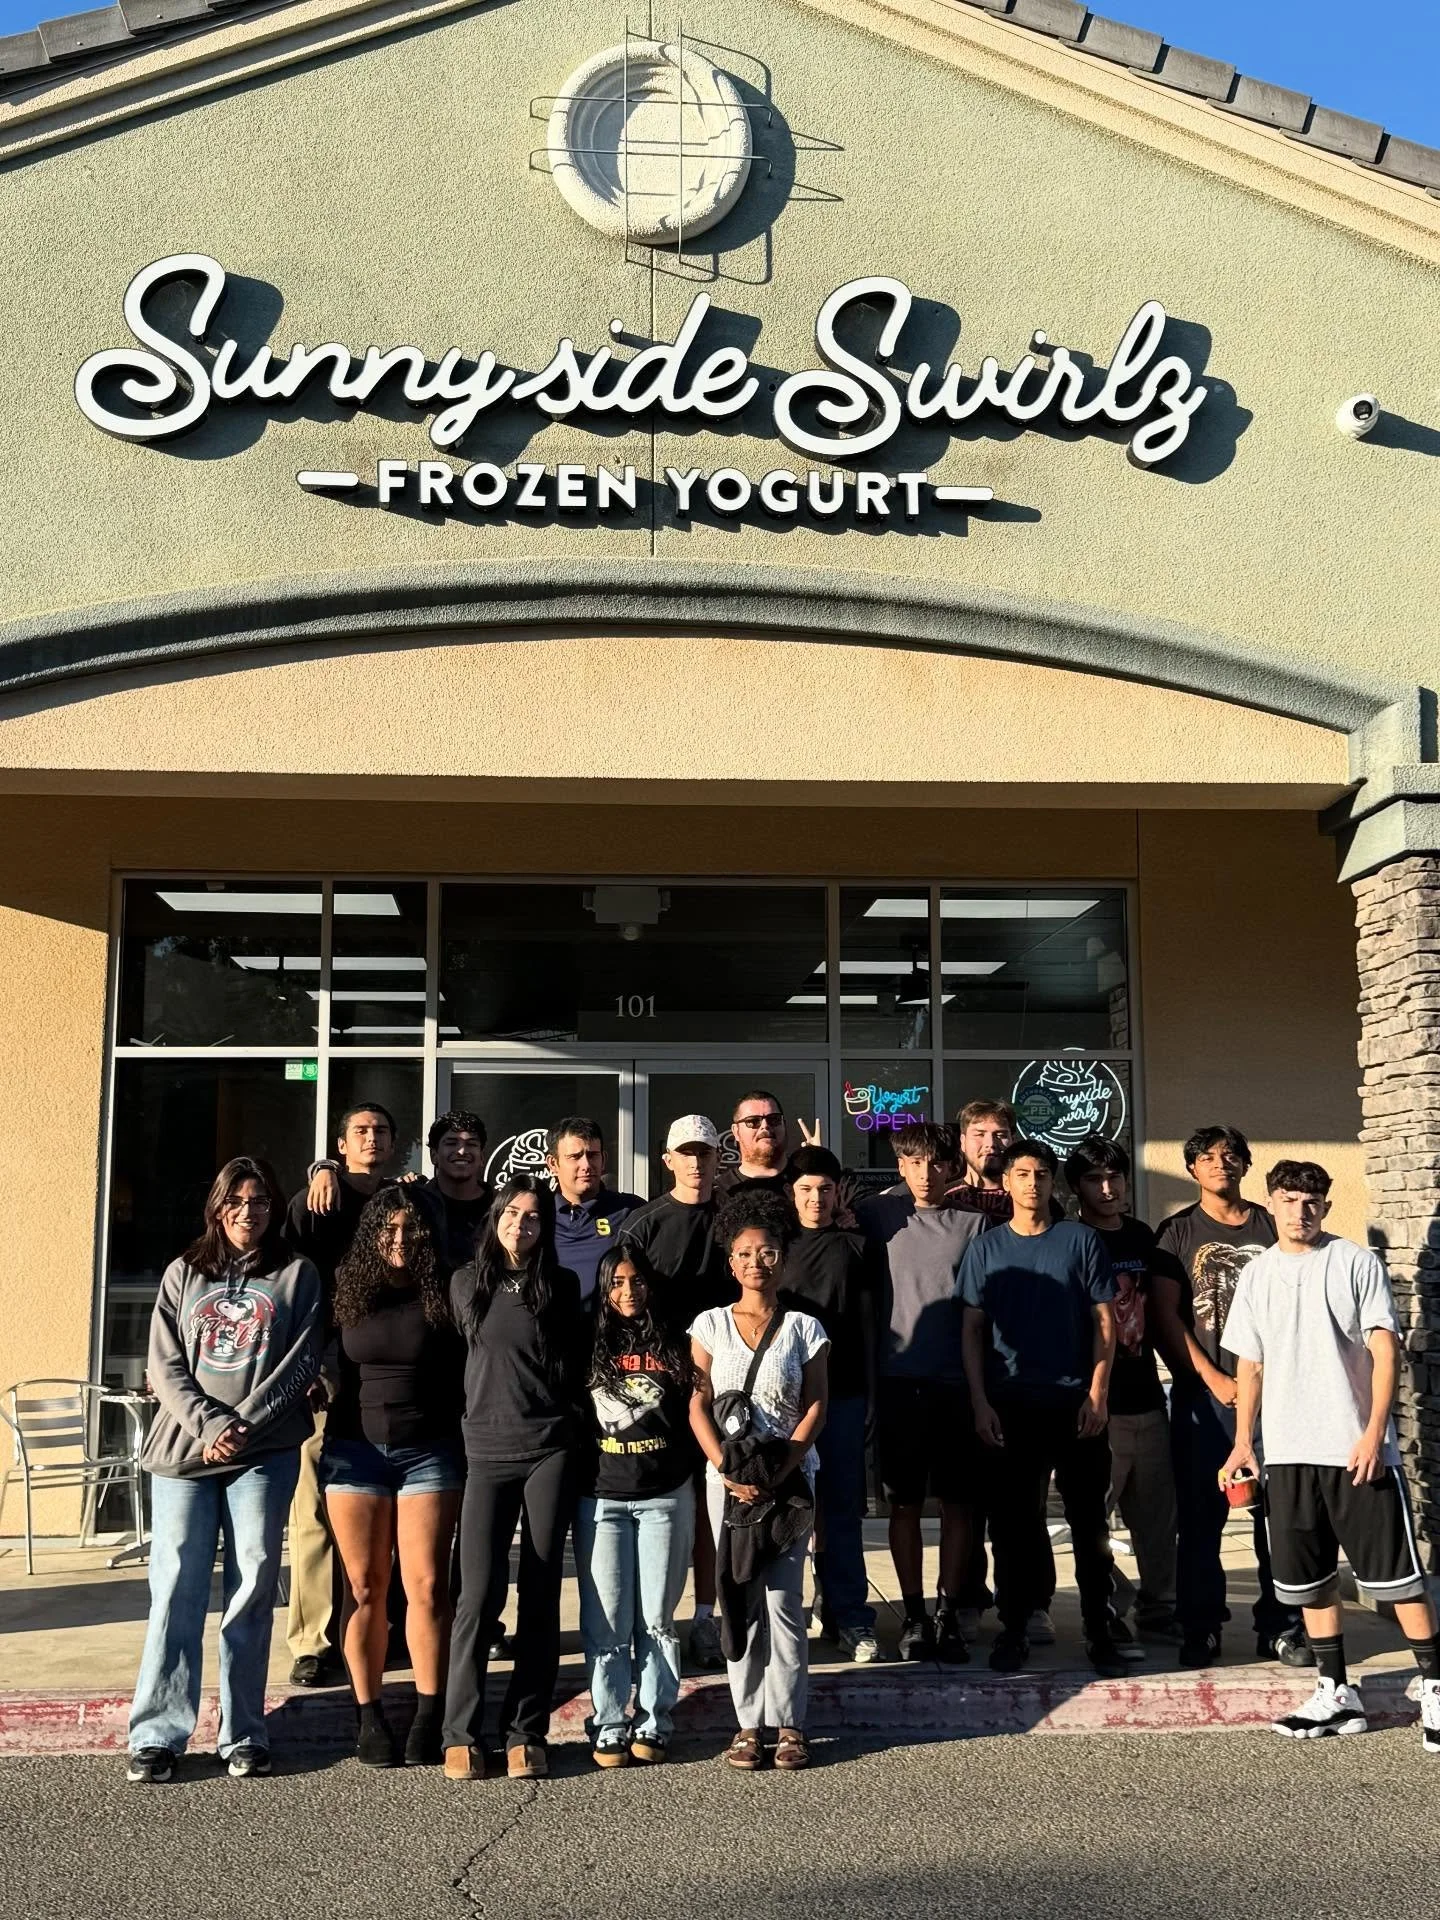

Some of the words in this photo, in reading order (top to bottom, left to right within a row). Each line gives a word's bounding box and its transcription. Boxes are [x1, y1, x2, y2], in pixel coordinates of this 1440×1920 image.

[774, 276, 1208, 462] Swirlz
[378, 460, 637, 509] FROZEN
[665, 467, 928, 516] YOGURT
[615, 995, 657, 1018] 101
[867, 1084, 930, 1115] Yogurt
[1058, 1080, 1113, 1110] nyside
[595, 1217, 612, 1237] S
